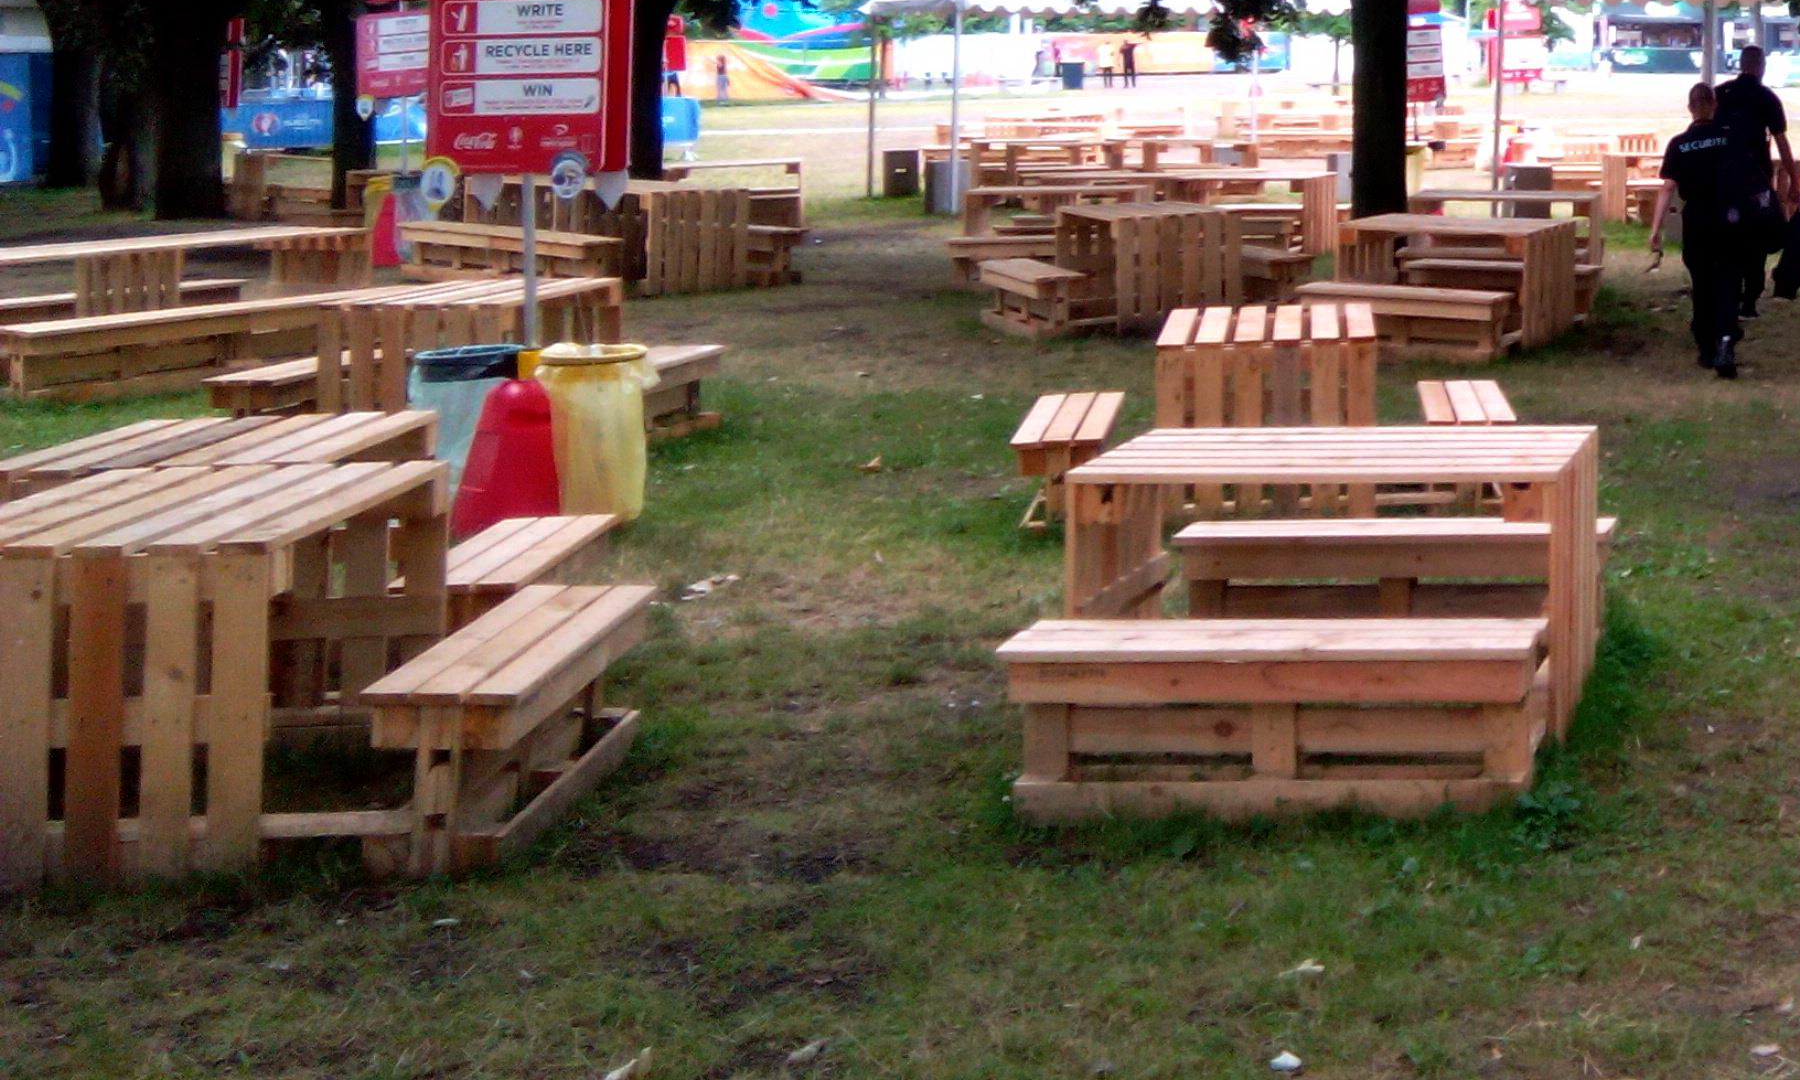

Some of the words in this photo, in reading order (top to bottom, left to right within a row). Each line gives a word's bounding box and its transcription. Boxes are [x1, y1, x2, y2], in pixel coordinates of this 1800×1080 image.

[516, 3, 564, 17] WRITE
[485, 44, 550, 58] RECYCLE
[554, 42, 593, 56] HERE
[522, 84, 553, 97] WIN
